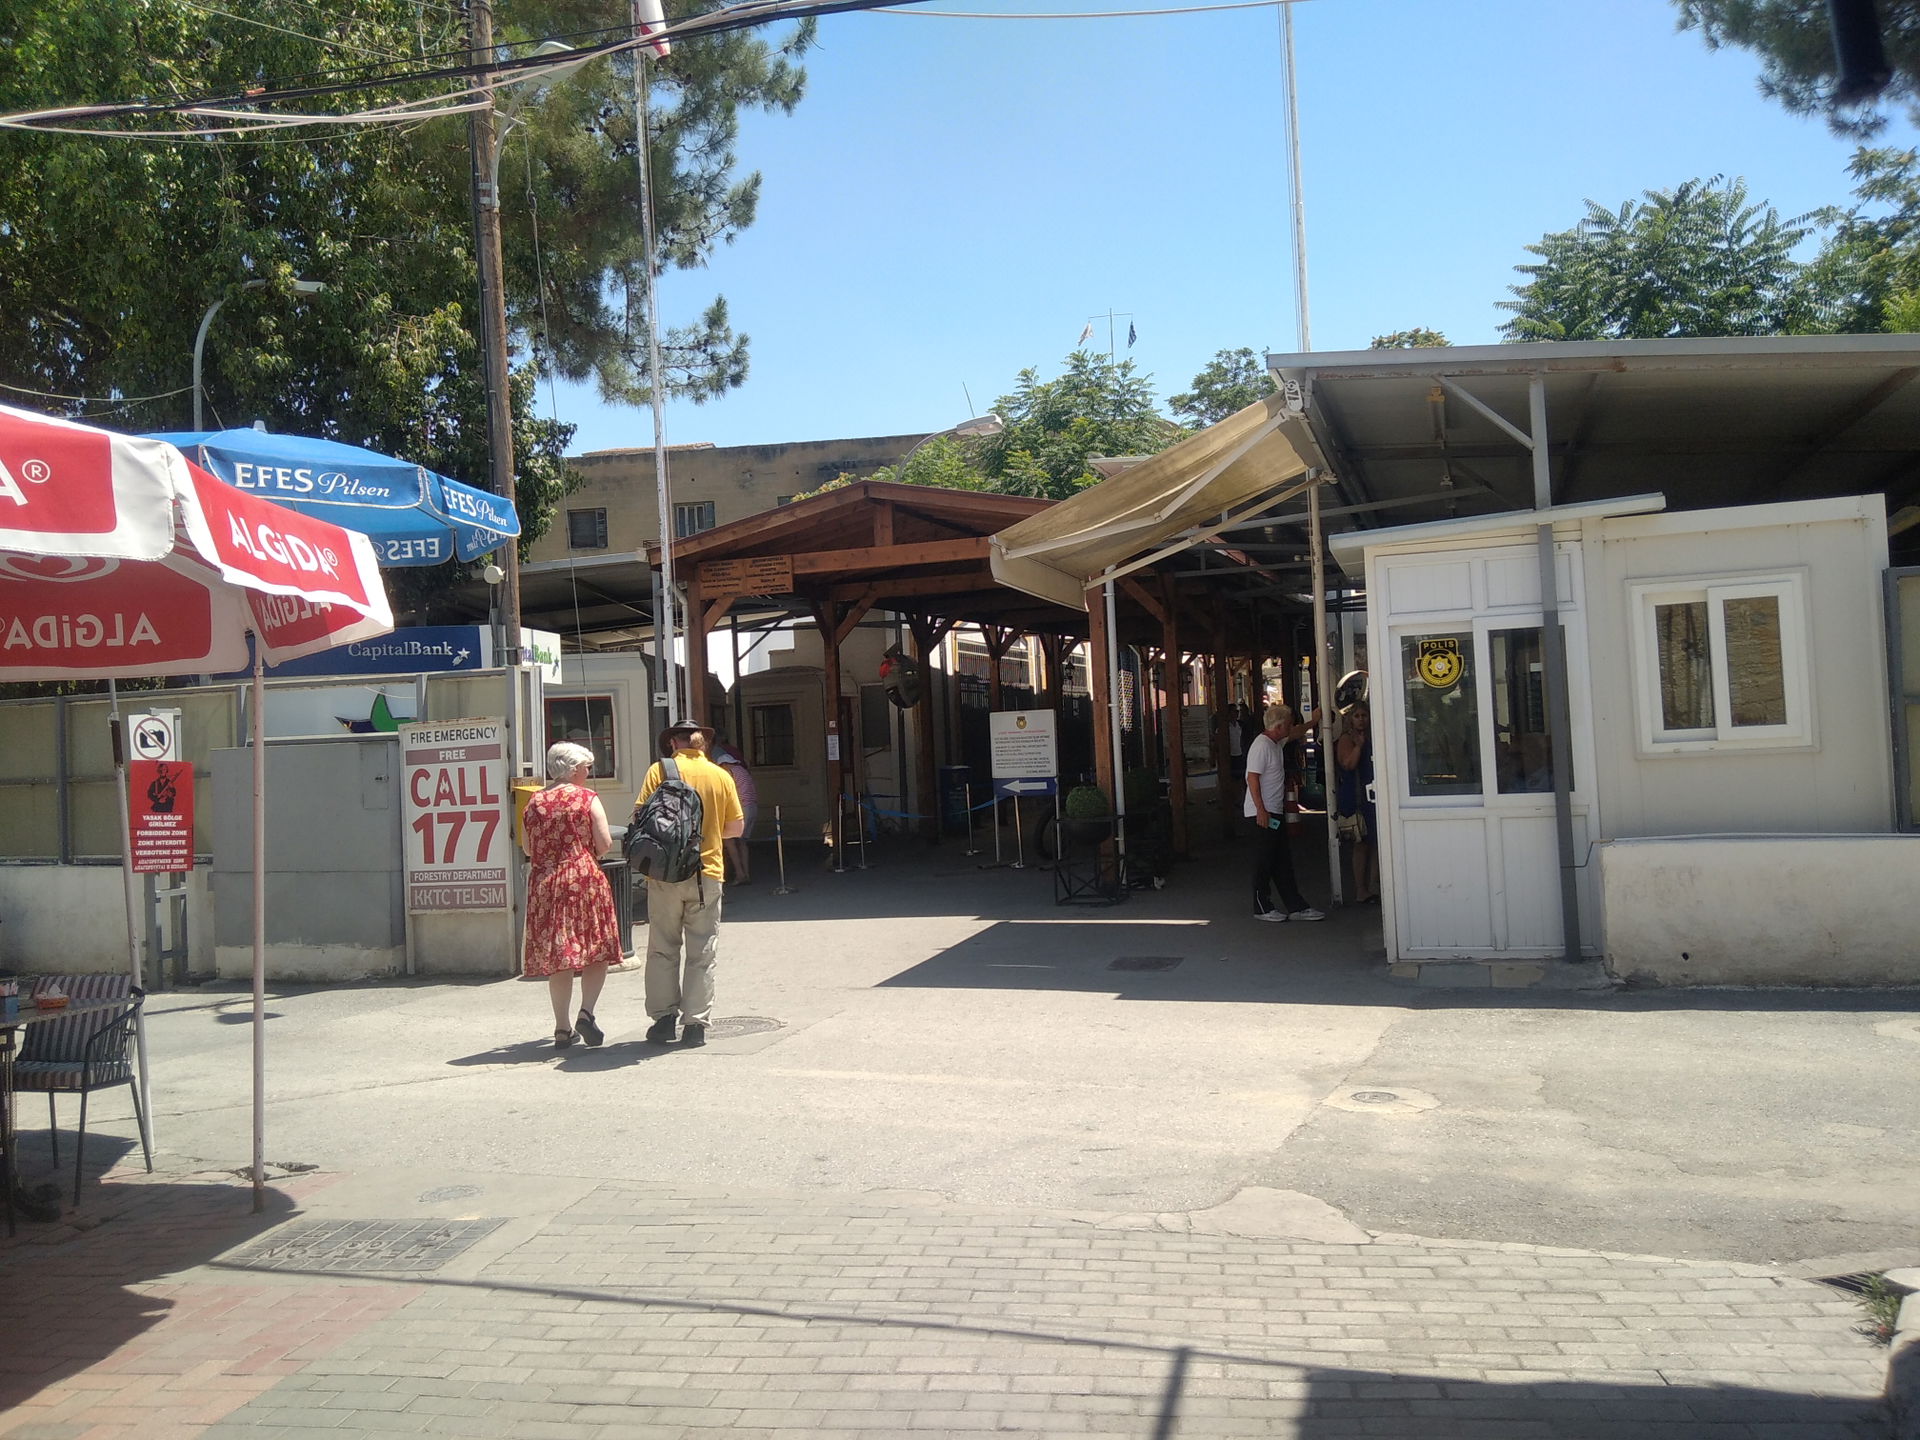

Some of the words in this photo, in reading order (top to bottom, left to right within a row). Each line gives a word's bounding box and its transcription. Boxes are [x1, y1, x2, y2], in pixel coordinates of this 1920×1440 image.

[234, 462, 313, 493] EFES
[317, 471, 390, 497] Pilsen
[440, 485, 477, 517] EFES
[348, 641, 453, 661] CapitalBank
[410, 731, 432, 744] FIRE
[434, 727, 497, 742] EMERGENCY
[439, 749, 466, 761] FREE
[410, 766, 499, 808] CALL
[412, 810, 500, 864] 177
[414, 871, 452, 882] FORESTRY
[453, 869, 502, 880] DEPARTMENT
[414, 889, 450, 906] KKTC
